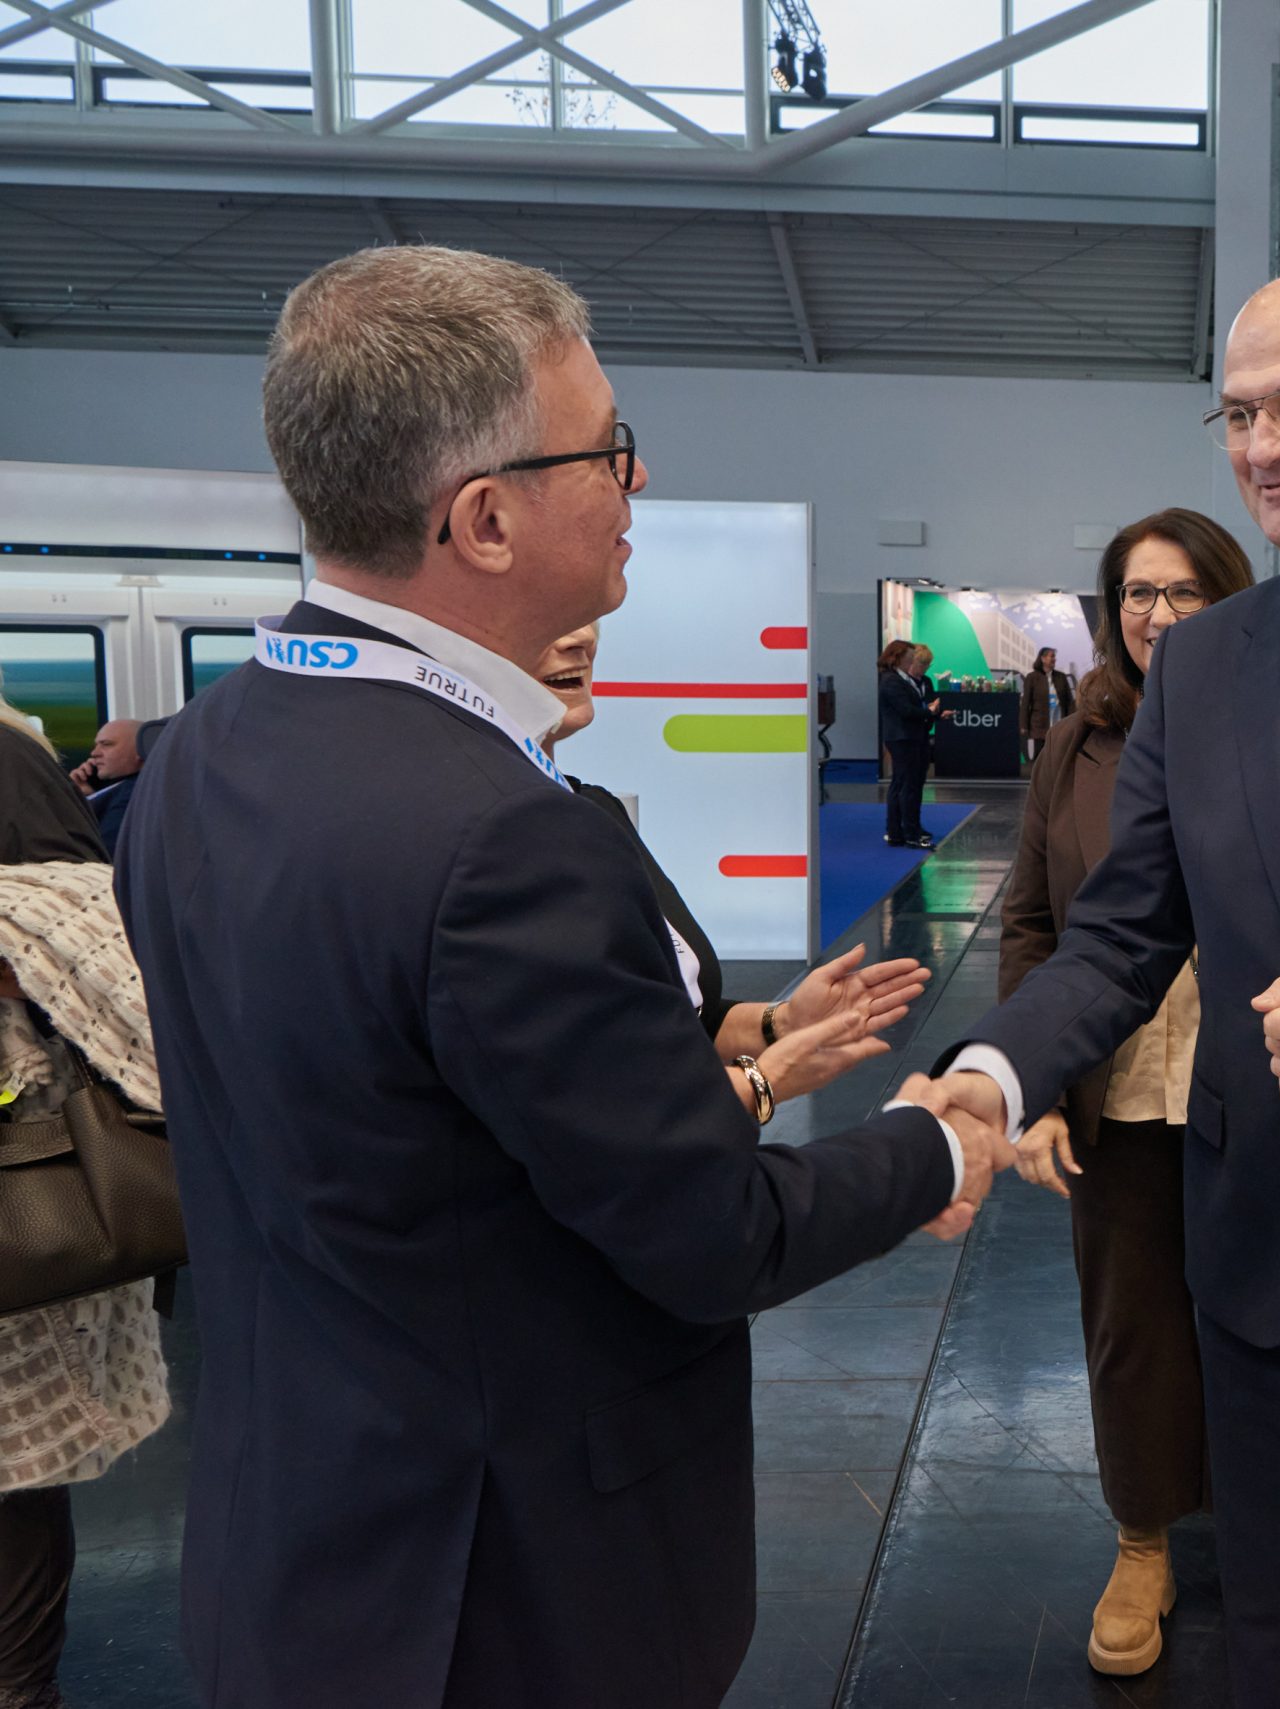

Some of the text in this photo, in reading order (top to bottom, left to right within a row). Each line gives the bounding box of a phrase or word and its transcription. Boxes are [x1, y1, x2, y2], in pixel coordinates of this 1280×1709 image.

[287, 639, 359, 670] CSU
[414, 665, 495, 718] FUTRUE
[953, 709, 1002, 727] Uber
